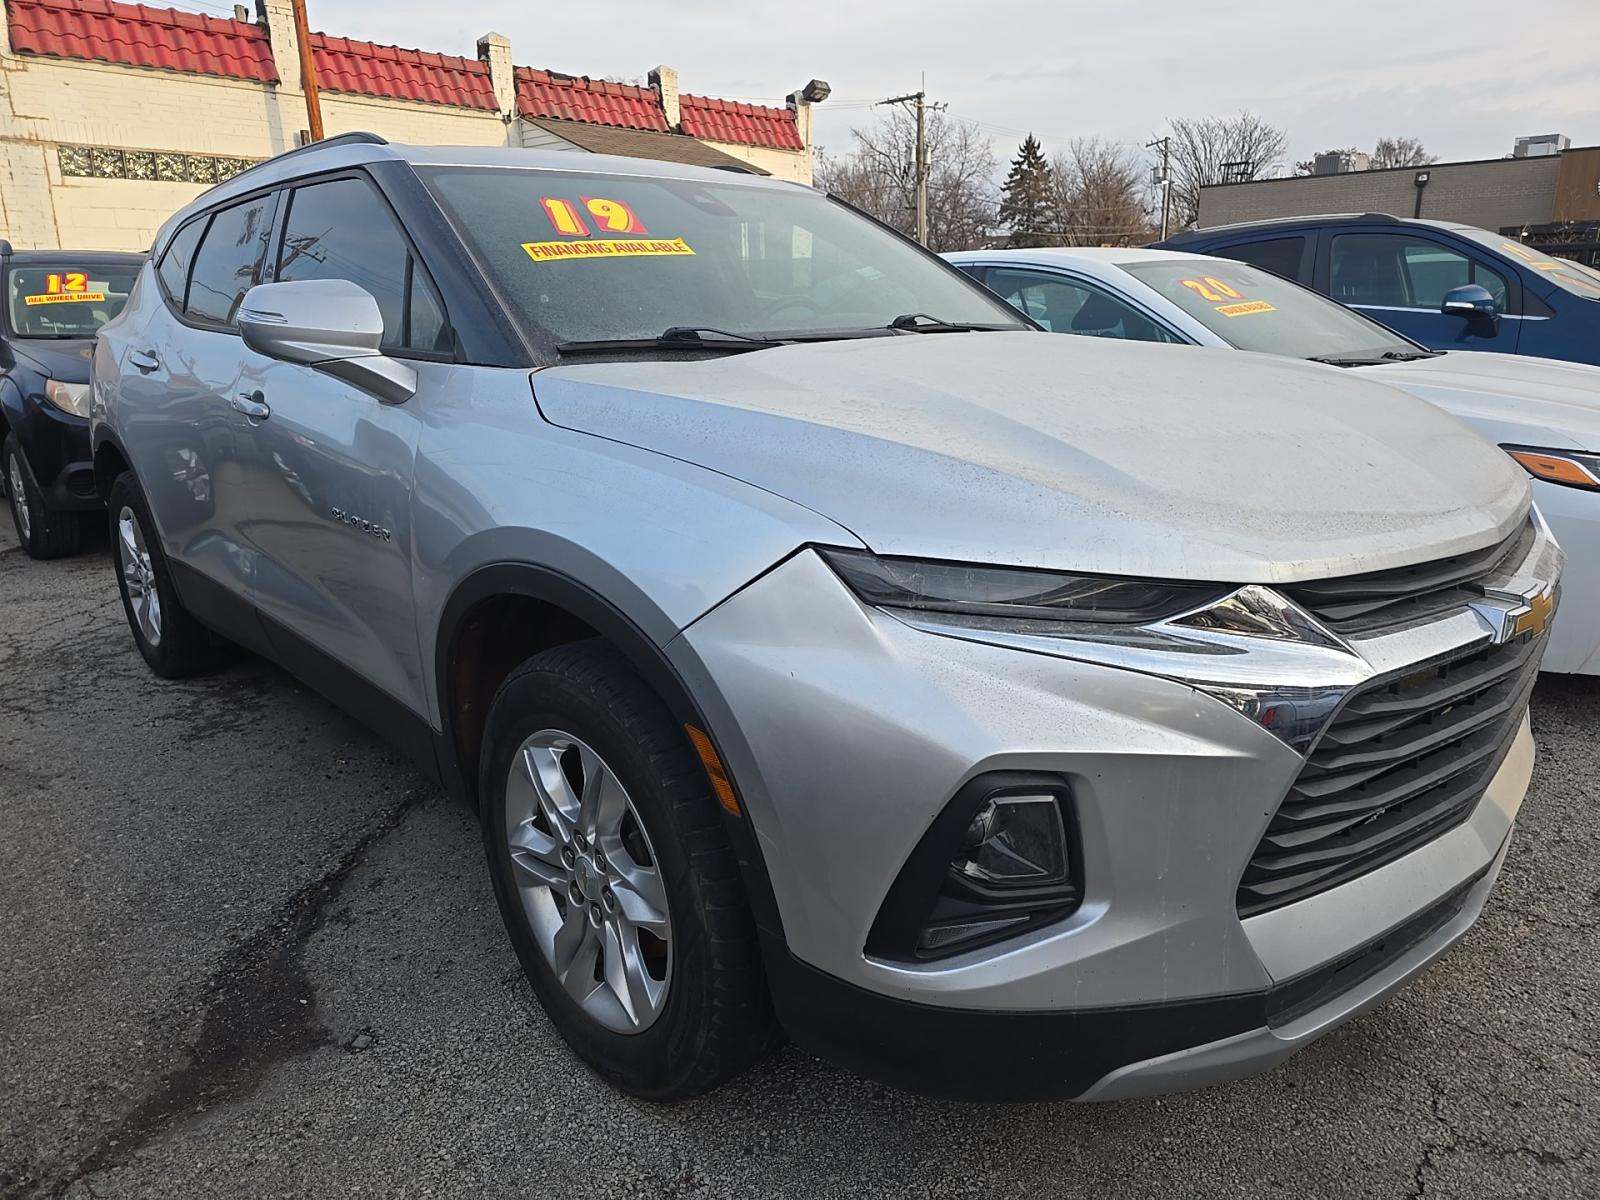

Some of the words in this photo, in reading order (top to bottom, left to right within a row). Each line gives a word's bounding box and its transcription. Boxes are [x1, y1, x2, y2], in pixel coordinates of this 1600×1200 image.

[545, 198, 634, 234] 19
[531, 242, 612, 258] FINANCING
[615, 241, 689, 253] AVAILABLE
[47, 273, 87, 294] 12
[1182, 277, 1240, 302] 20
